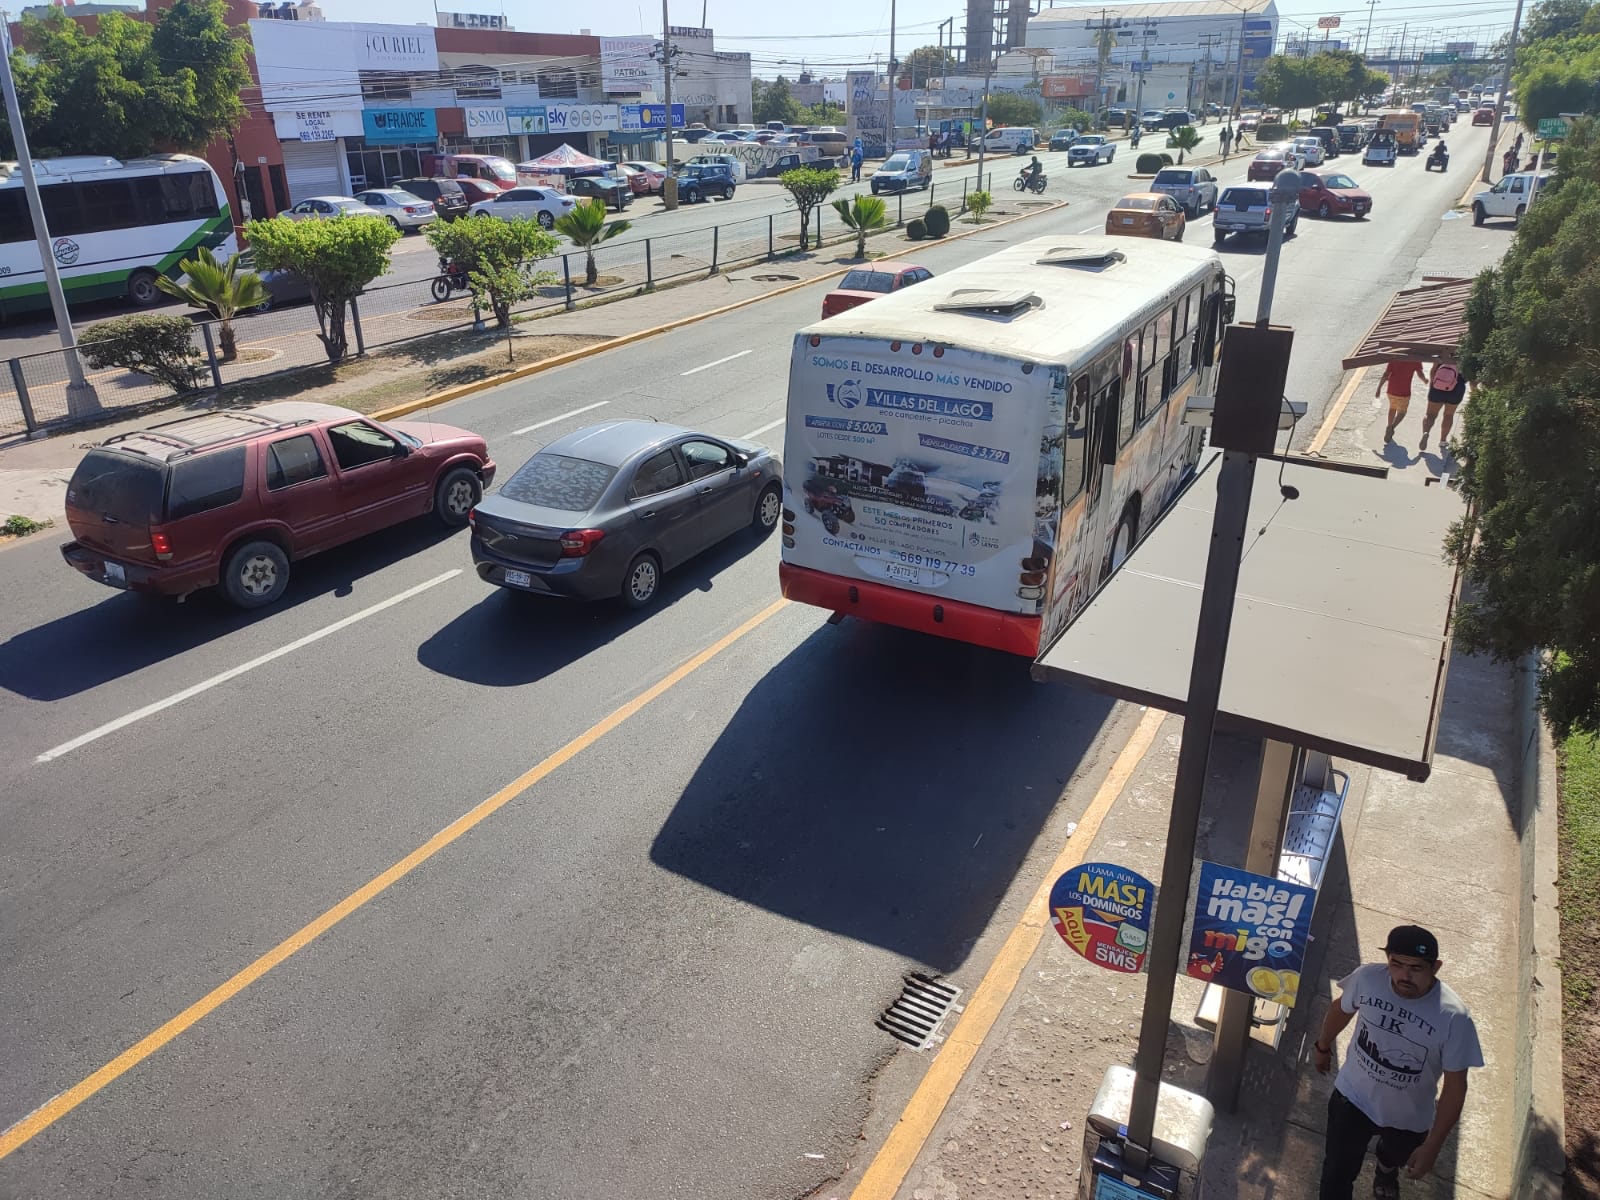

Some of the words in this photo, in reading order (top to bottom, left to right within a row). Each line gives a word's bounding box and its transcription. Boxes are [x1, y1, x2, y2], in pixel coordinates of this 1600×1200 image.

[373, 36, 425, 53] CURIEL
[296, 111, 307, 120] SE
[308, 111, 331, 119] RENTA
[387, 111, 427, 128] FRAICHE
[478, 109, 503, 123] SMO
[549, 108, 567, 127] sky
[812, 356, 848, 370] SOMOS
[851, 361, 862, 372] EL
[865, 362, 934, 382] DESARROLLO
[936, 371, 960, 386] MÁS
[963, 376, 1012, 394] VENDIDO
[873, 391, 915, 409] VILLAS
[918, 399, 938, 412] DEL
[944, 402, 984, 418] LAGO
[854, 421, 882, 433] 5,000
[863, 506, 881, 514] ESTE
[912, 516, 953, 530] PRIMEROS
[874, 517, 887, 525] 50
[889, 521, 939, 535] COMPRADORES
[900, 551, 922, 565] 669
[925, 556, 941, 569] 119
[945, 561, 958, 572] 77
[960, 564, 976, 577] 39
[1087, 865, 1114, 878] LLAMA
[1078, 872, 1146, 909] MÁS!
[1212, 878, 1290, 903] Habla
[1069, 891, 1082, 901] LOS
[1082, 894, 1142, 920] DOMINGOS
[1256, 925, 1293, 940] con
[1204, 929, 1293, 961] migo
[1095, 947, 1137, 970] SMS
[1360, 995, 1394, 1013] LARD
[1398, 1007, 1436, 1037] BUTT
[1380, 1014, 1405, 1035] 1K
[1391, 1072, 1422, 1084] 2016
